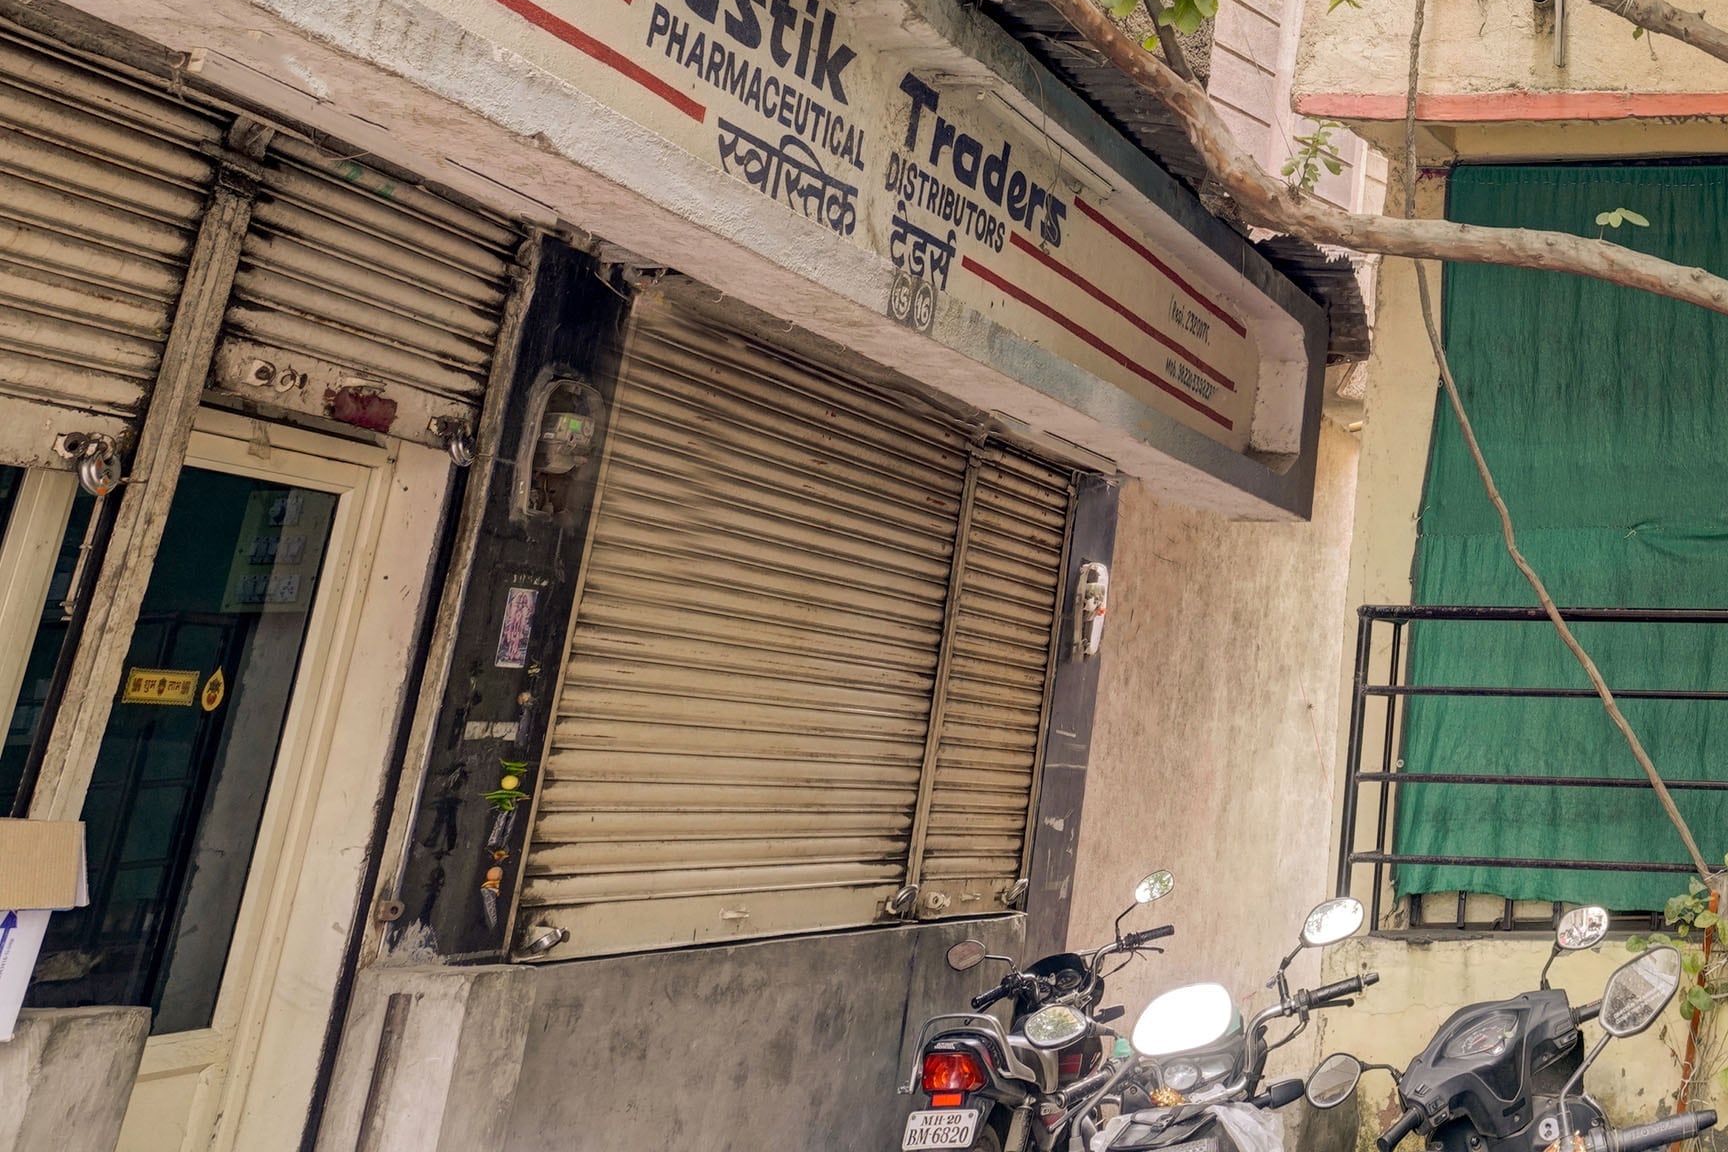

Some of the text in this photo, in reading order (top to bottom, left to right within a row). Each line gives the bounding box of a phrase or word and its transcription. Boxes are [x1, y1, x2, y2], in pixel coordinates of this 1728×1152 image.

[646, 2, 1005, 253] PHARMACEUTICAL DISTRIBUTORS
[718, 116, 859, 236] स्वस्तिक
[899, 71, 1067, 248] Traders
[915, 294, 930, 324] 16
[906, 1126, 969, 1146] BM-6820
